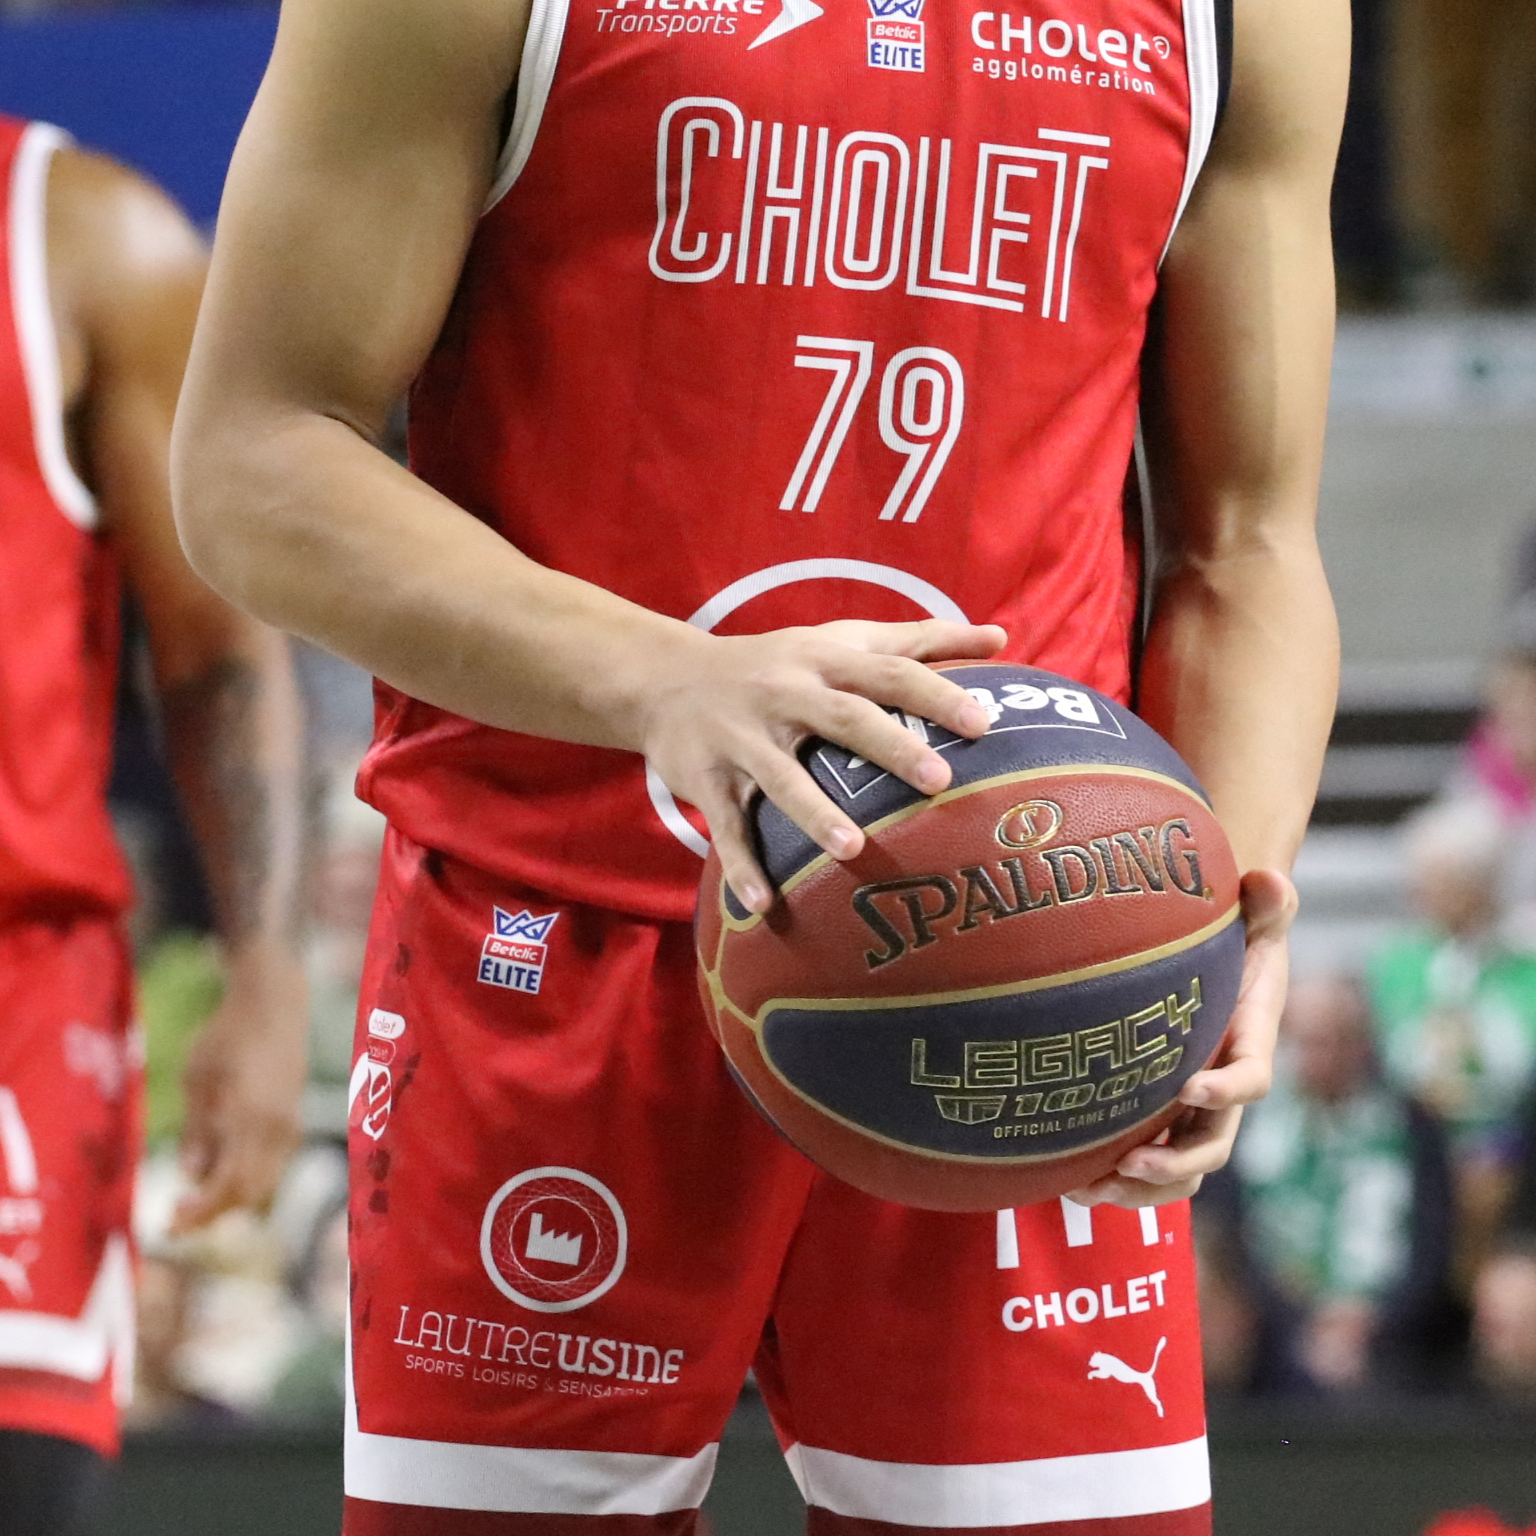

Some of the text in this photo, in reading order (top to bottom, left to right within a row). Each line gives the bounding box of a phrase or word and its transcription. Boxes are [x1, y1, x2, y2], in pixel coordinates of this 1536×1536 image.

[596, 9, 738, 38] Transports
[972, 56, 1156, 96] agglomération
[648, 96, 1111, 322] CHOLET
[778, 335, 964, 523] 79
[852, 818, 1205, 973] SPALDING
[479, 957, 540, 992] ÉLITE
[910, 976, 1204, 1089] LEGACY
[1015, 1046, 1184, 1116] 1000
[993, 1096, 1141, 1140] OFFICIAL GAME BALL
[1001, 1269, 1167, 1332] CHOLET
[405, 1353, 465, 1379] SPORTS
[472, 1367, 538, 1390] LOISIRS
